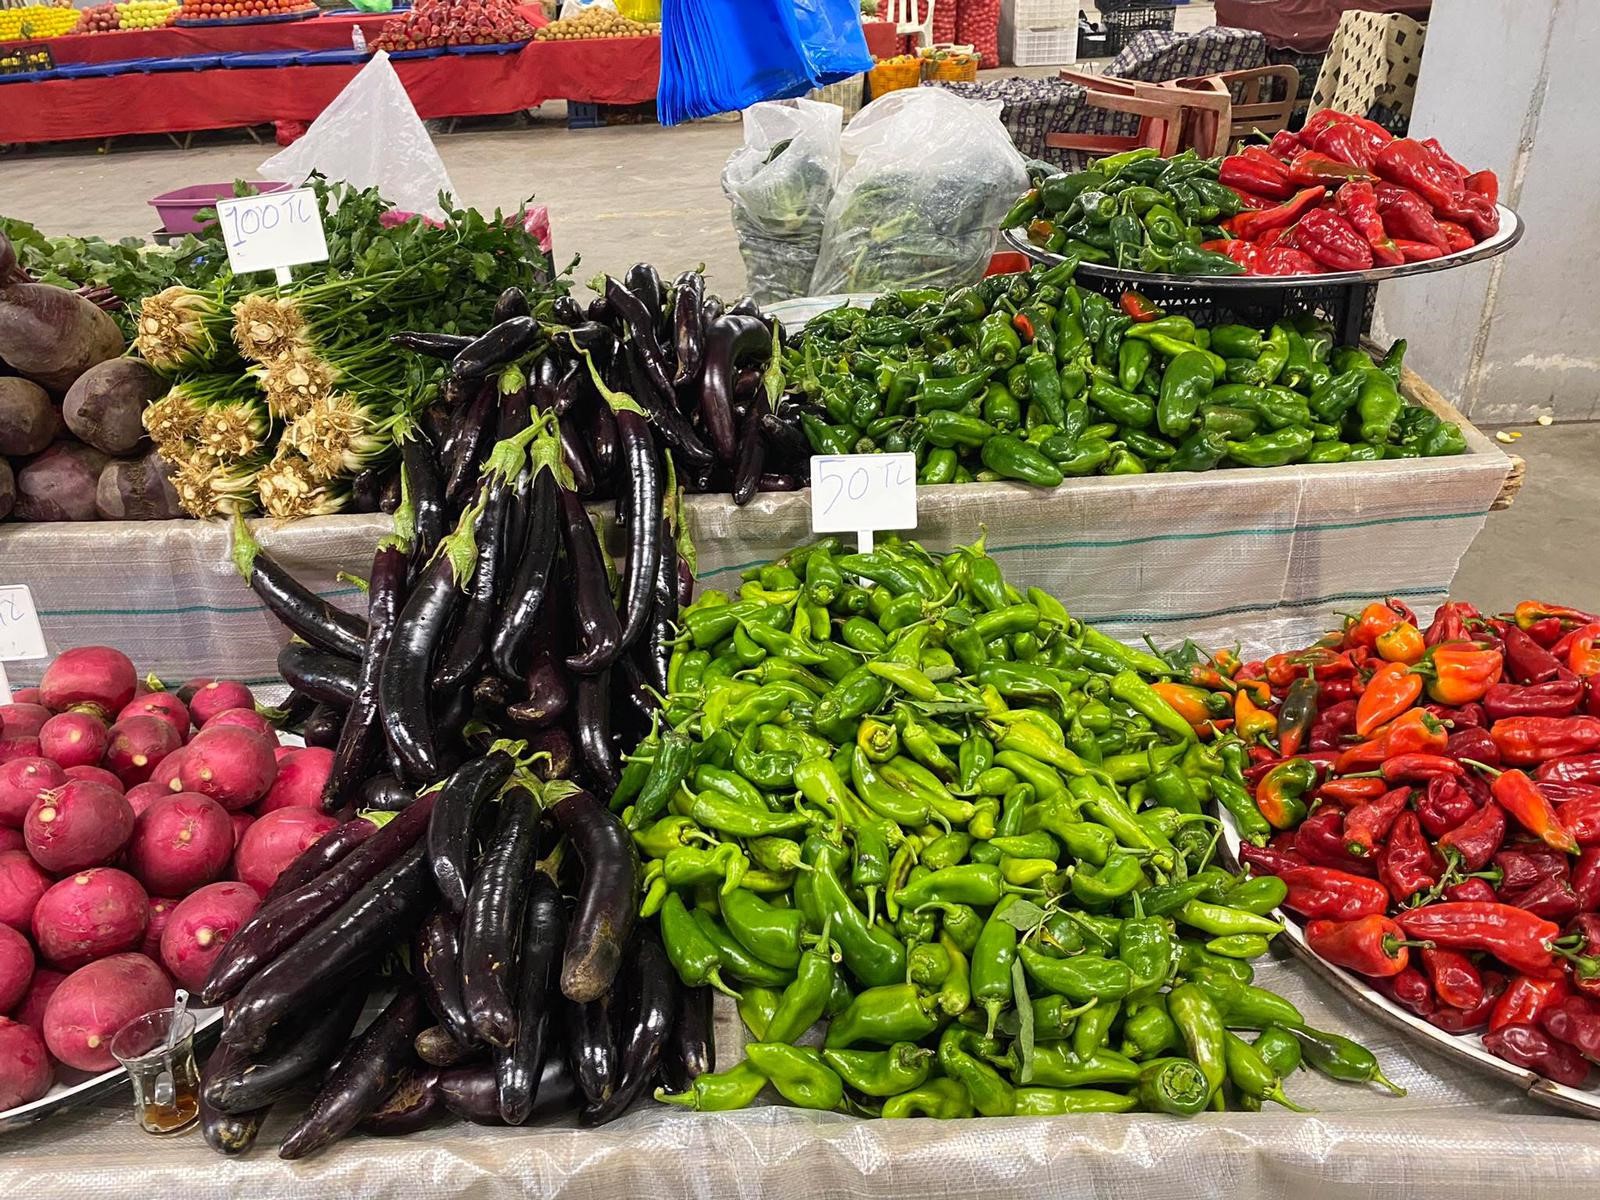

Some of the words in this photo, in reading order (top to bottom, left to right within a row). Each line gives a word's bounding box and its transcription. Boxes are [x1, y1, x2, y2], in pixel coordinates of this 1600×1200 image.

[225, 204, 279, 247] 100
[281, 194, 312, 224] TL
[817, 459, 869, 516] 50
[884, 459, 911, 488] TL
